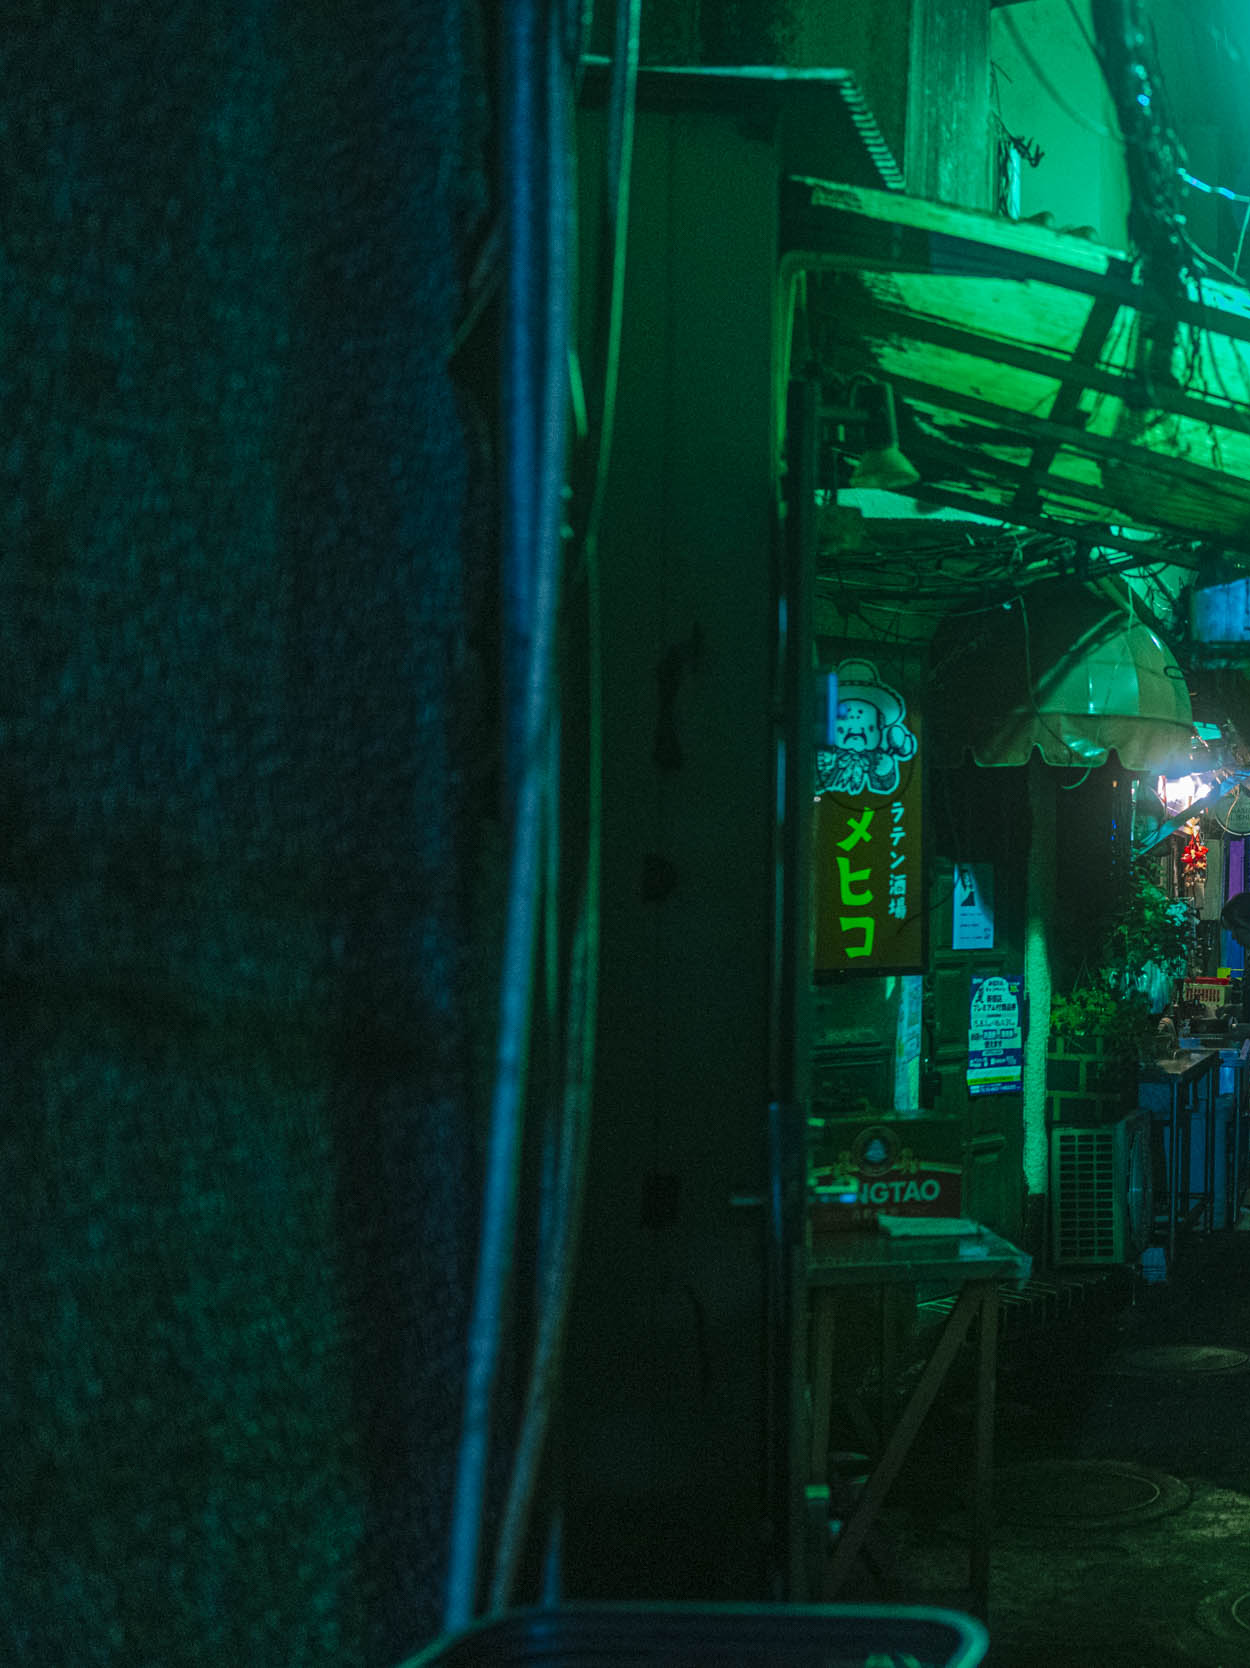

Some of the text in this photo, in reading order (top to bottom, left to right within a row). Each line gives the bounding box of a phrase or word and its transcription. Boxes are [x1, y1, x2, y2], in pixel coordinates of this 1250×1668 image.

[836, 807, 875, 958] メヒコ
[888, 802, 907, 919] ラテン酒場
